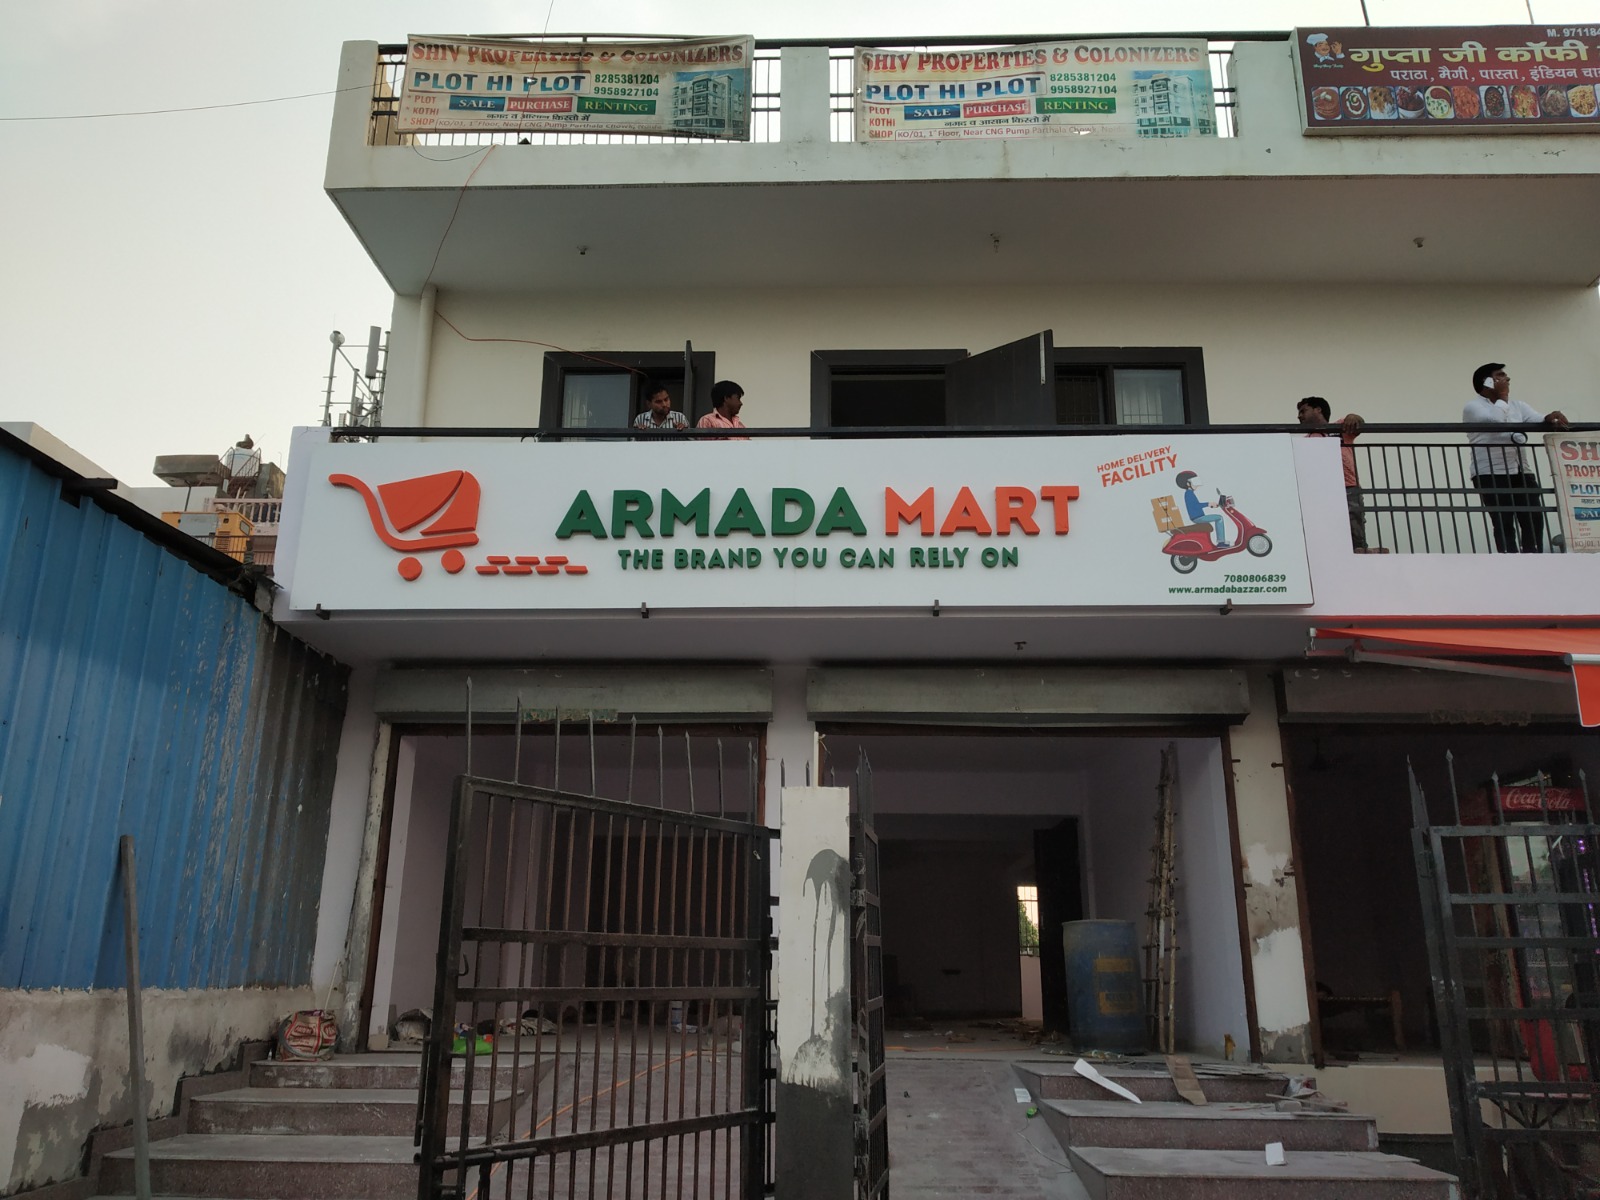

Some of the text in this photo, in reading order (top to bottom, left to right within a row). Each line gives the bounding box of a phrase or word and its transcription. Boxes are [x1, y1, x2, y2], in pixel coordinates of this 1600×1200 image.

[1547, 28, 1560, 37] M.
[412, 43, 461, 62] SHIV
[1348, 47, 1432, 72] गुप्ता
[1439, 40, 1487, 62] जी
[1495, 39, 1589, 62] कॉफी
[862, 45, 1200, 72] SHIV PROPERTIES & COLONIZERS
[1050, 72, 1116, 82] 8285381204
[1529, 65, 1577, 81] इंडियन
[414, 71, 586, 92] PLOT HI PLOT
[594, 73, 659, 85] 8285381204
[593, 86, 659, 97] 9958927104
[866, 77, 1041, 100] PLOT HI PLOT
[1051, 85, 1117, 95] 9958927104
[414, 94, 437, 104] PLOT
[458, 98, 496, 109] SALE
[509, 98, 570, 109] PURCHASE
[412, 106, 439, 116] KOTHI
[584, 101, 649, 112] RENTING
[869, 106, 890, 115] PLOT
[965, 102, 1030, 115] PURCHASE
[1044, 101, 1108, 110] RENTING
[913, 108, 951, 117] SALE
[409, 117, 435, 127] SHOP
[869, 118, 896, 127] KOTHI
[868, 130, 893, 139] SHOP
[938, 129, 961, 138] Floor,
[985, 128, 1004, 136] CNG
[1005, 127, 1030, 137] Pump
[1560, 440, 1600, 461] SH
[1097, 445, 1172, 473] HOME DELIVERY
[1101, 454, 1178, 488] FACILITY
[555, 485, 1080, 540] ARMADA MART
[617, 546, 1019, 571] THE BRAND YOU CAN RELY ON
[1223, 574, 1286, 583] 7080806839
[1168, 584, 1287, 594] www.armadabazzar.com
[1506, 788, 1572, 810] Coca-Cola
